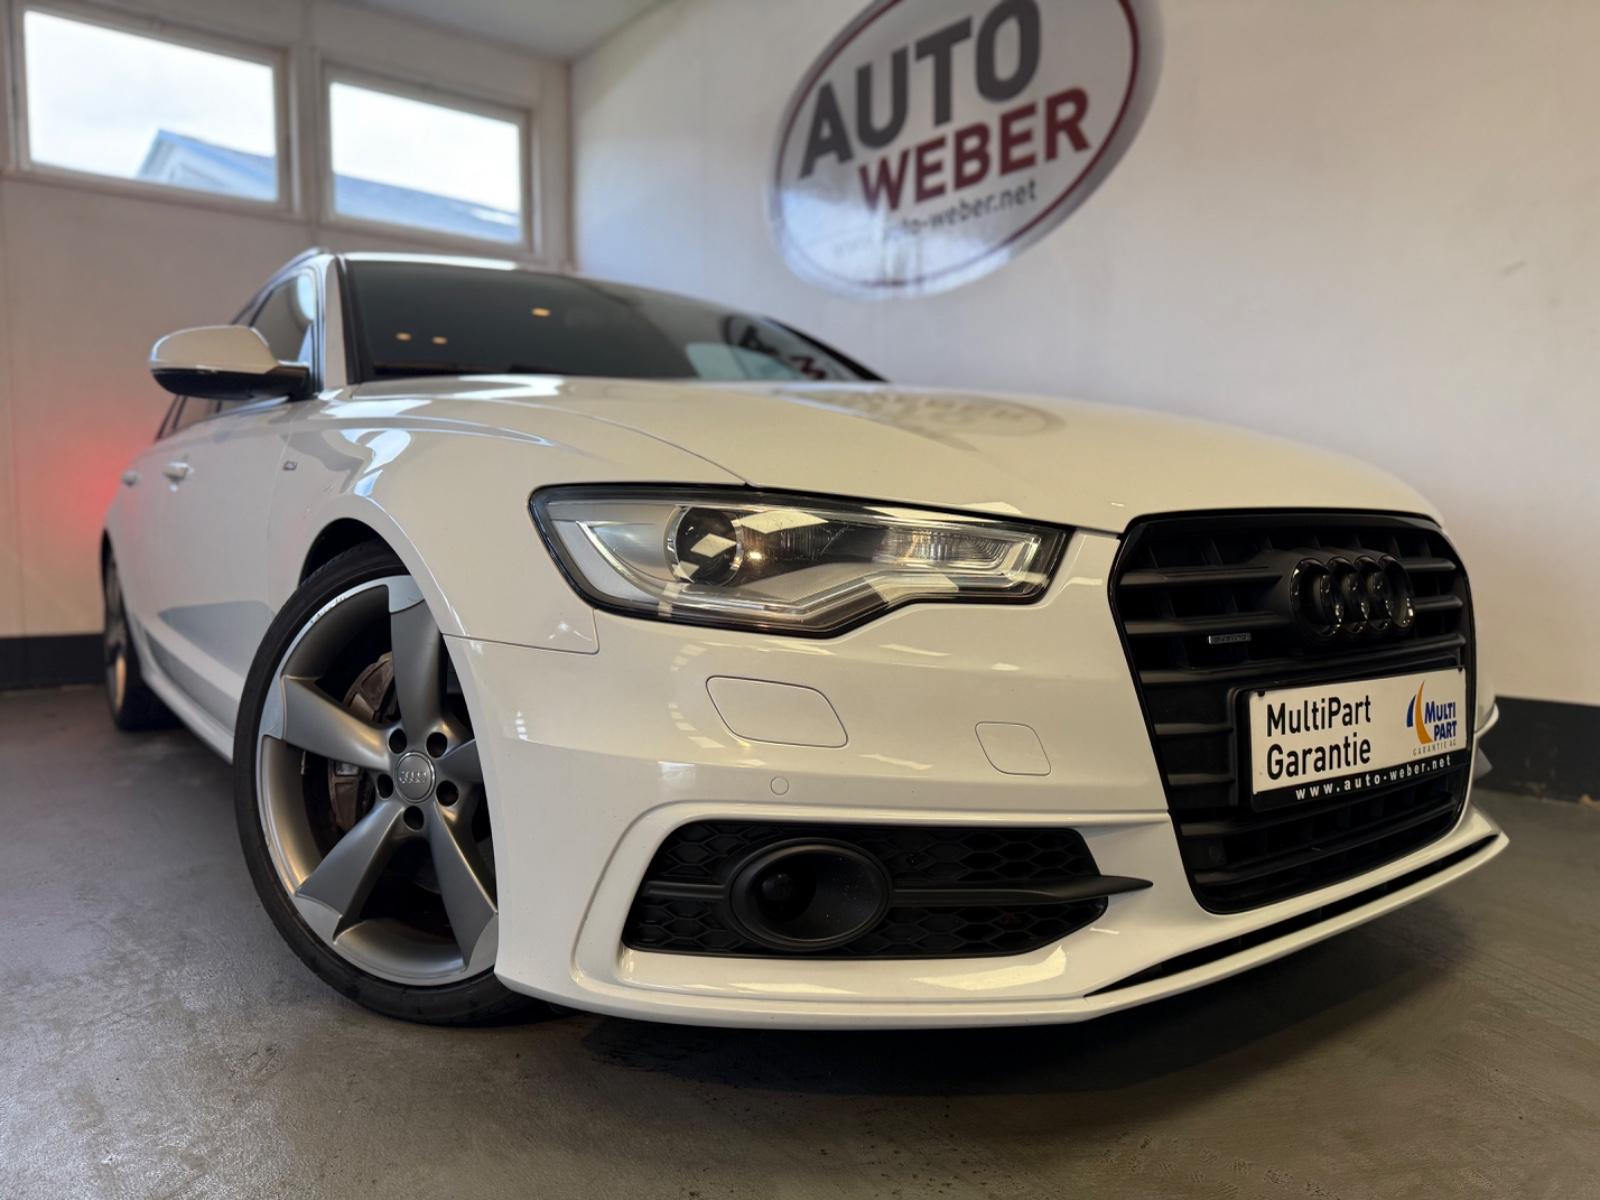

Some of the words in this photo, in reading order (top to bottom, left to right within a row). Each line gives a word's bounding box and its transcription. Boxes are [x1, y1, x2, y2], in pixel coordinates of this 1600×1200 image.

[800, 0, 1041, 179] AUTO
[859, 87, 1090, 212] WEBER
[1266, 695, 1371, 737] MultiPart
[1424, 700, 1456, 724] MULTI
[1433, 720, 1457, 742] PART
[1266, 733, 1371, 780] Garantie
[1295, 755, 1451, 800] www.auto-weber.net
